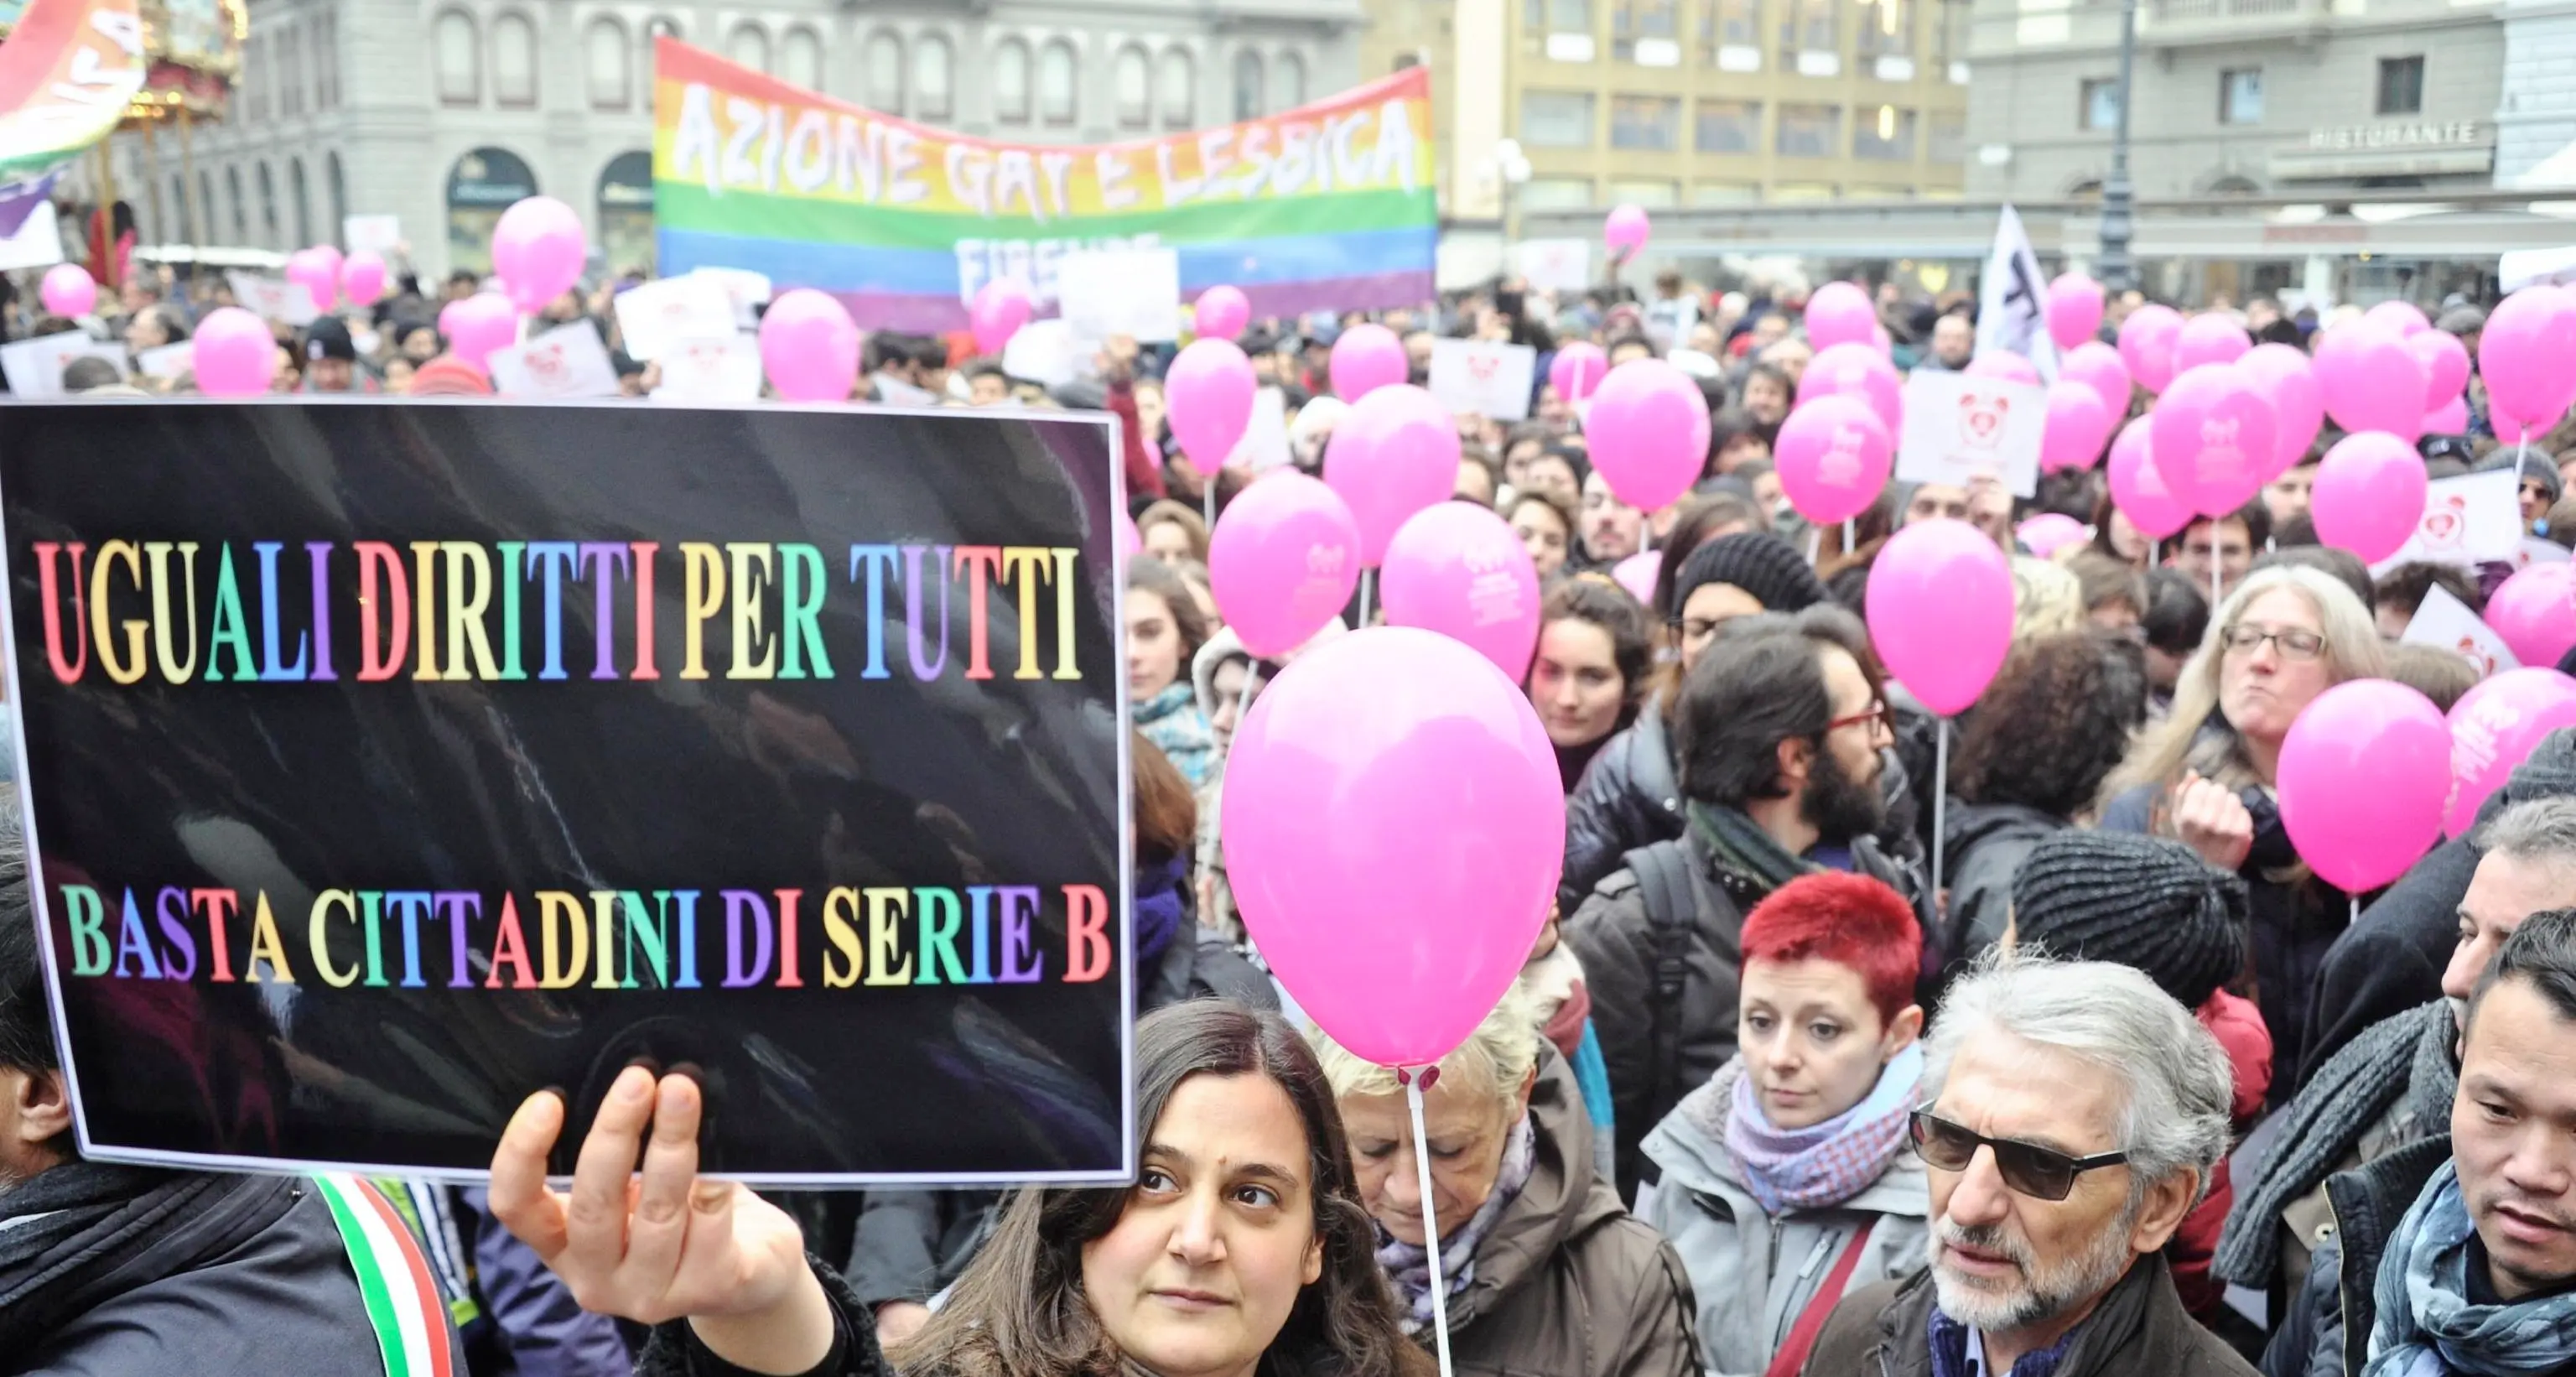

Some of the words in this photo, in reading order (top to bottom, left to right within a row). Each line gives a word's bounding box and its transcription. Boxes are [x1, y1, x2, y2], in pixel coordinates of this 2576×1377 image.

[673, 82, 928, 200] AZIONE
[943, 143, 1072, 225] GAY
[1095, 149, 1140, 211] E
[1156, 98, 1419, 198] LESBICA
[2309, 120, 2475, 148] RISTORANTE
[954, 232, 1161, 312] FIRE
[32, 539, 338, 684] UGUALI
[353, 541, 660, 681] DIRITTI
[678, 542, 834, 680] PER
[849, 543, 1083, 681] TUTTI
[60, 884, 295, 984] BASTA
[309, 887, 703, 990] CITTADINI
[719, 889, 804, 989] DI
[822, 886, 1044, 989] SERIE
[1061, 884, 1112, 984] B
